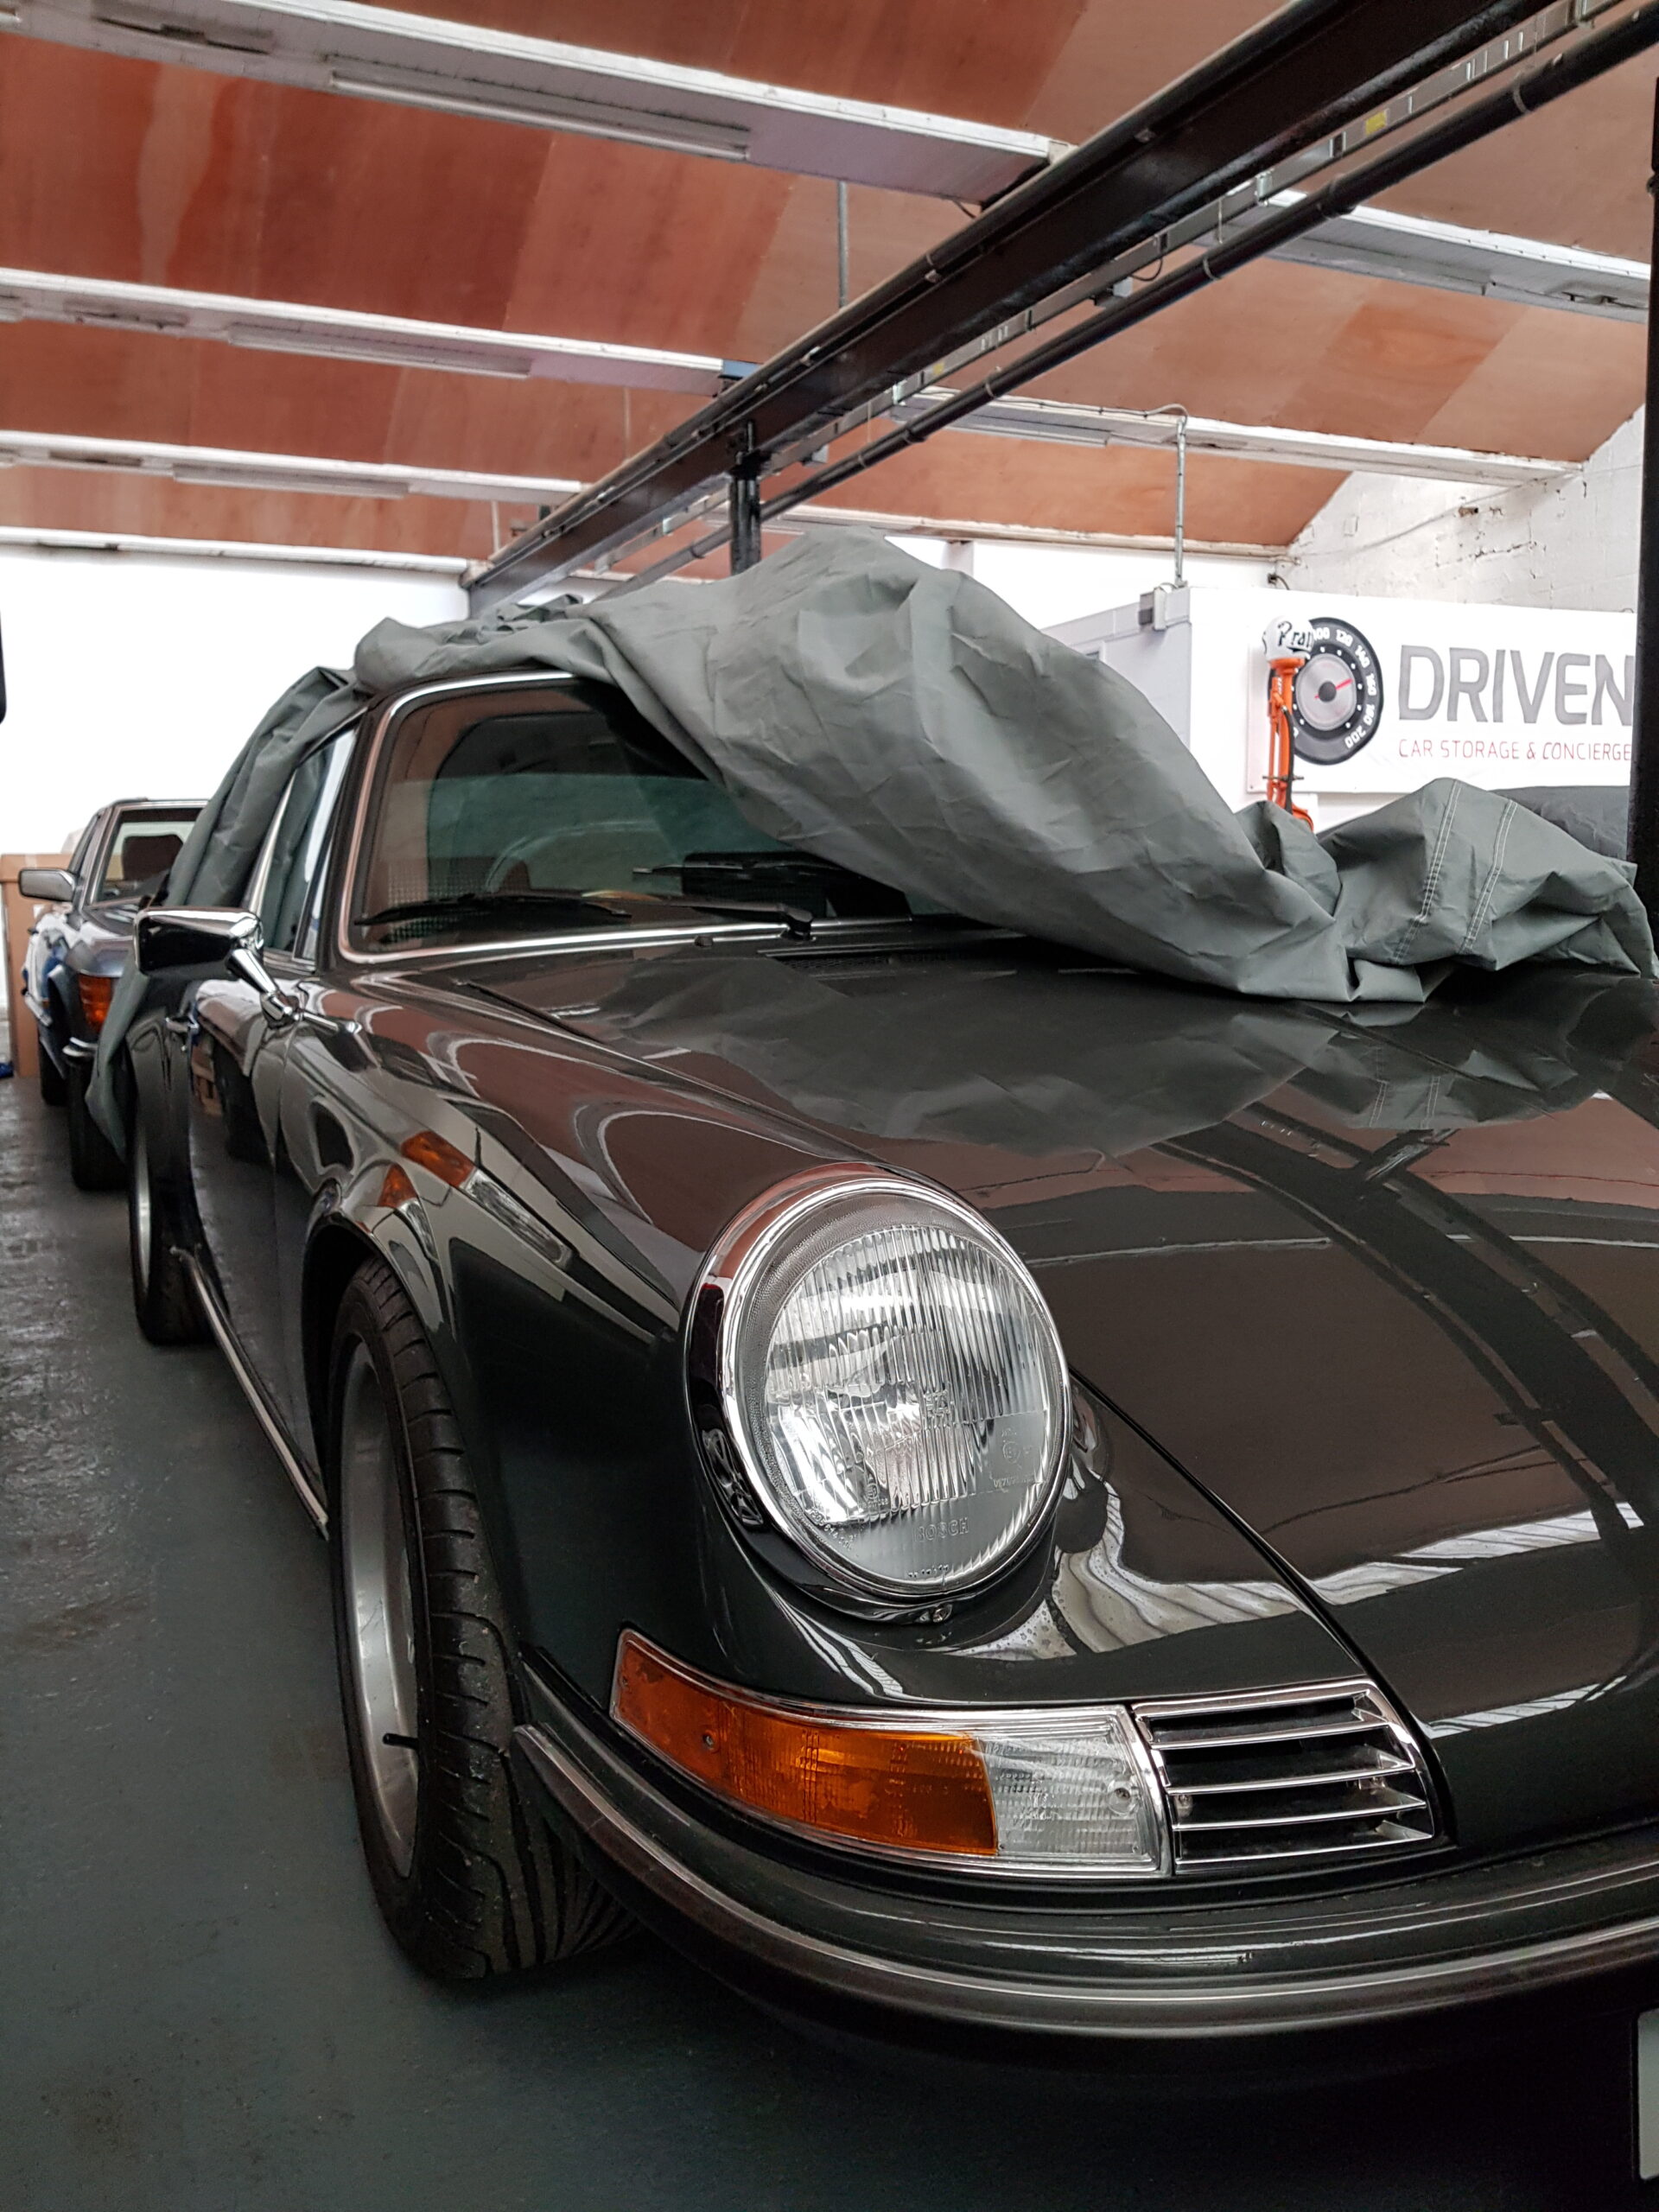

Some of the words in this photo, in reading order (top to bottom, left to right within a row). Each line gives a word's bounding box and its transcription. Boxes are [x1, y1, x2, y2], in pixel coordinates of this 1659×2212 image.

[1336, 629, 1353, 647] 120
[1355, 645, 1370, 668] 140
[1366, 673, 1377, 696] 160
[1398, 645, 1634, 726] DRIVEN
[1344, 725, 1366, 748] 200
[1399, 739, 1433, 758] CAR
[1440, 740, 1519, 760] STORAGE
[1527, 741, 1535, 760] &
[1542, 741, 1631, 761] CONCIERGE
[912, 1516, 969, 1542] BOSCH
